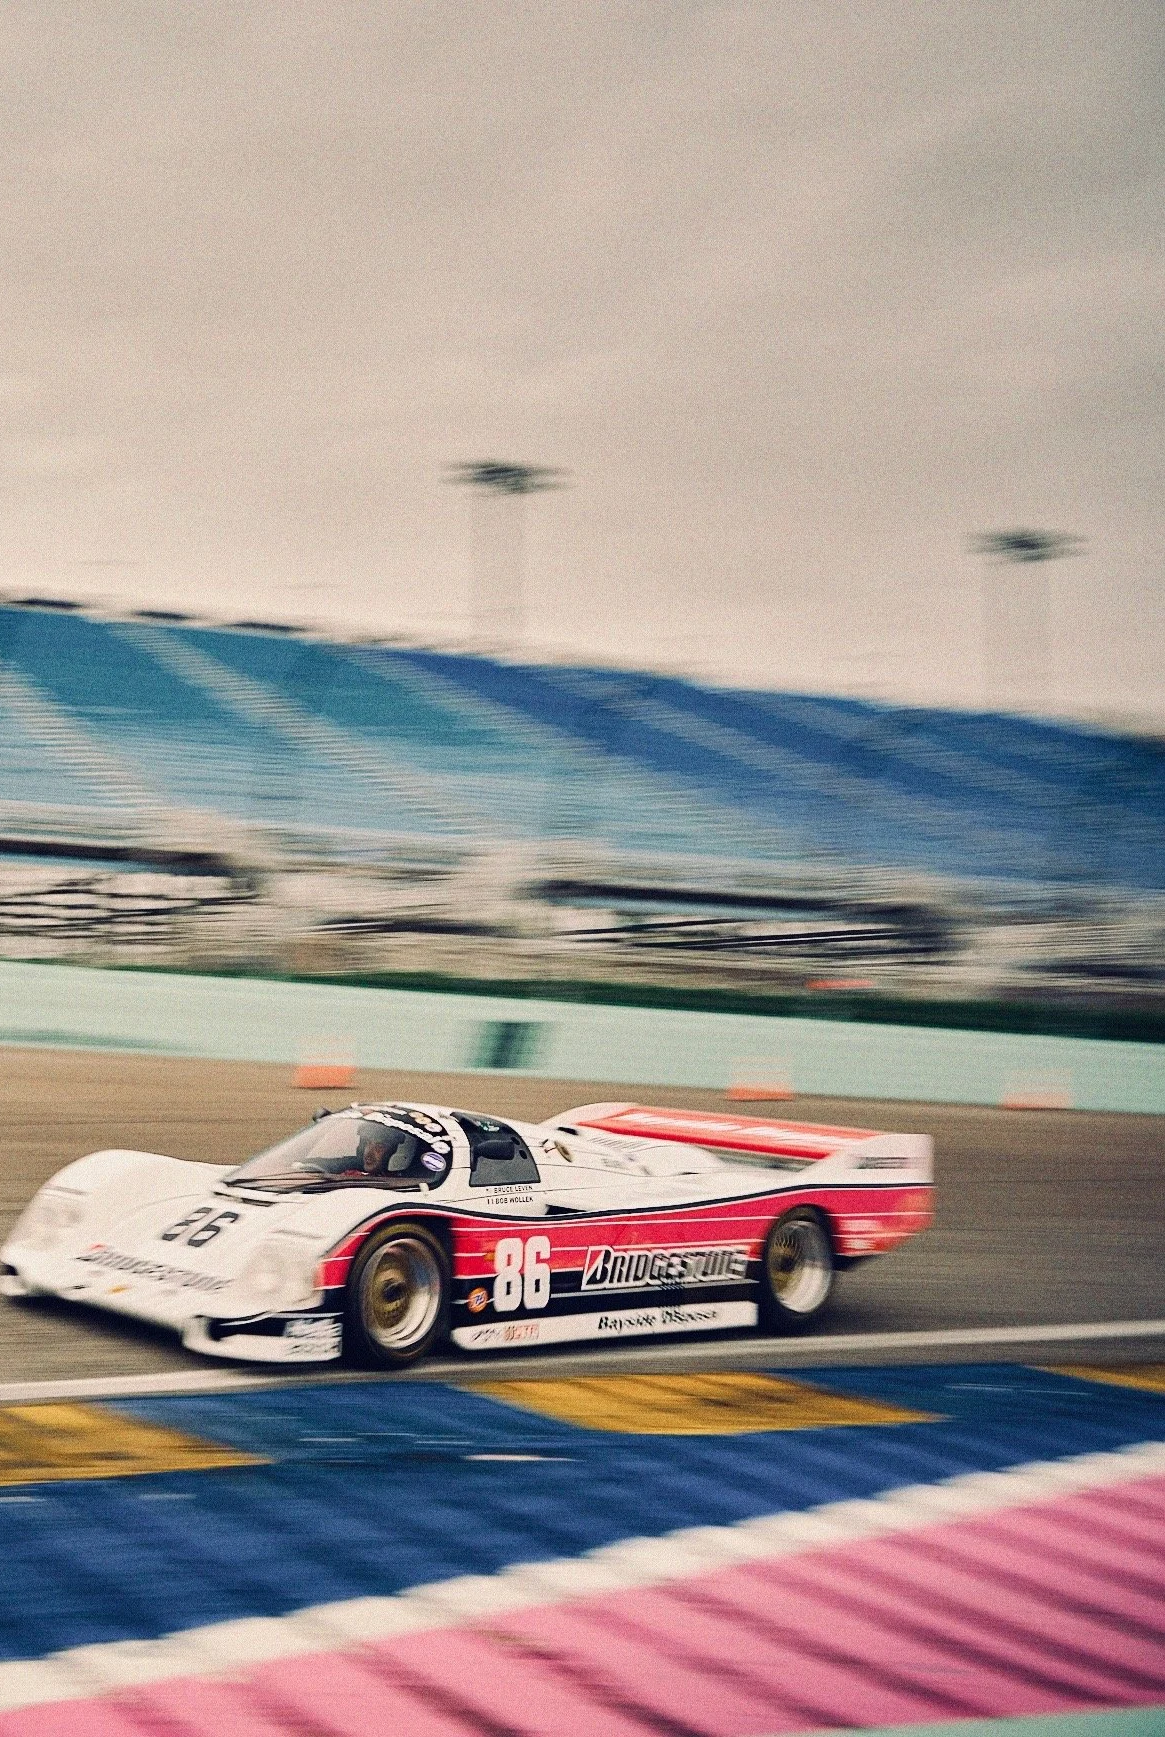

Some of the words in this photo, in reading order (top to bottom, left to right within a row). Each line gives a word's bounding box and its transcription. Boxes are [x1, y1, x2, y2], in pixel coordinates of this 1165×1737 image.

[509, 1196, 534, 1204] WOLLEK
[493, 1235, 550, 1312] 86
[582, 1246, 750, 1290] BRIDGESTONE
